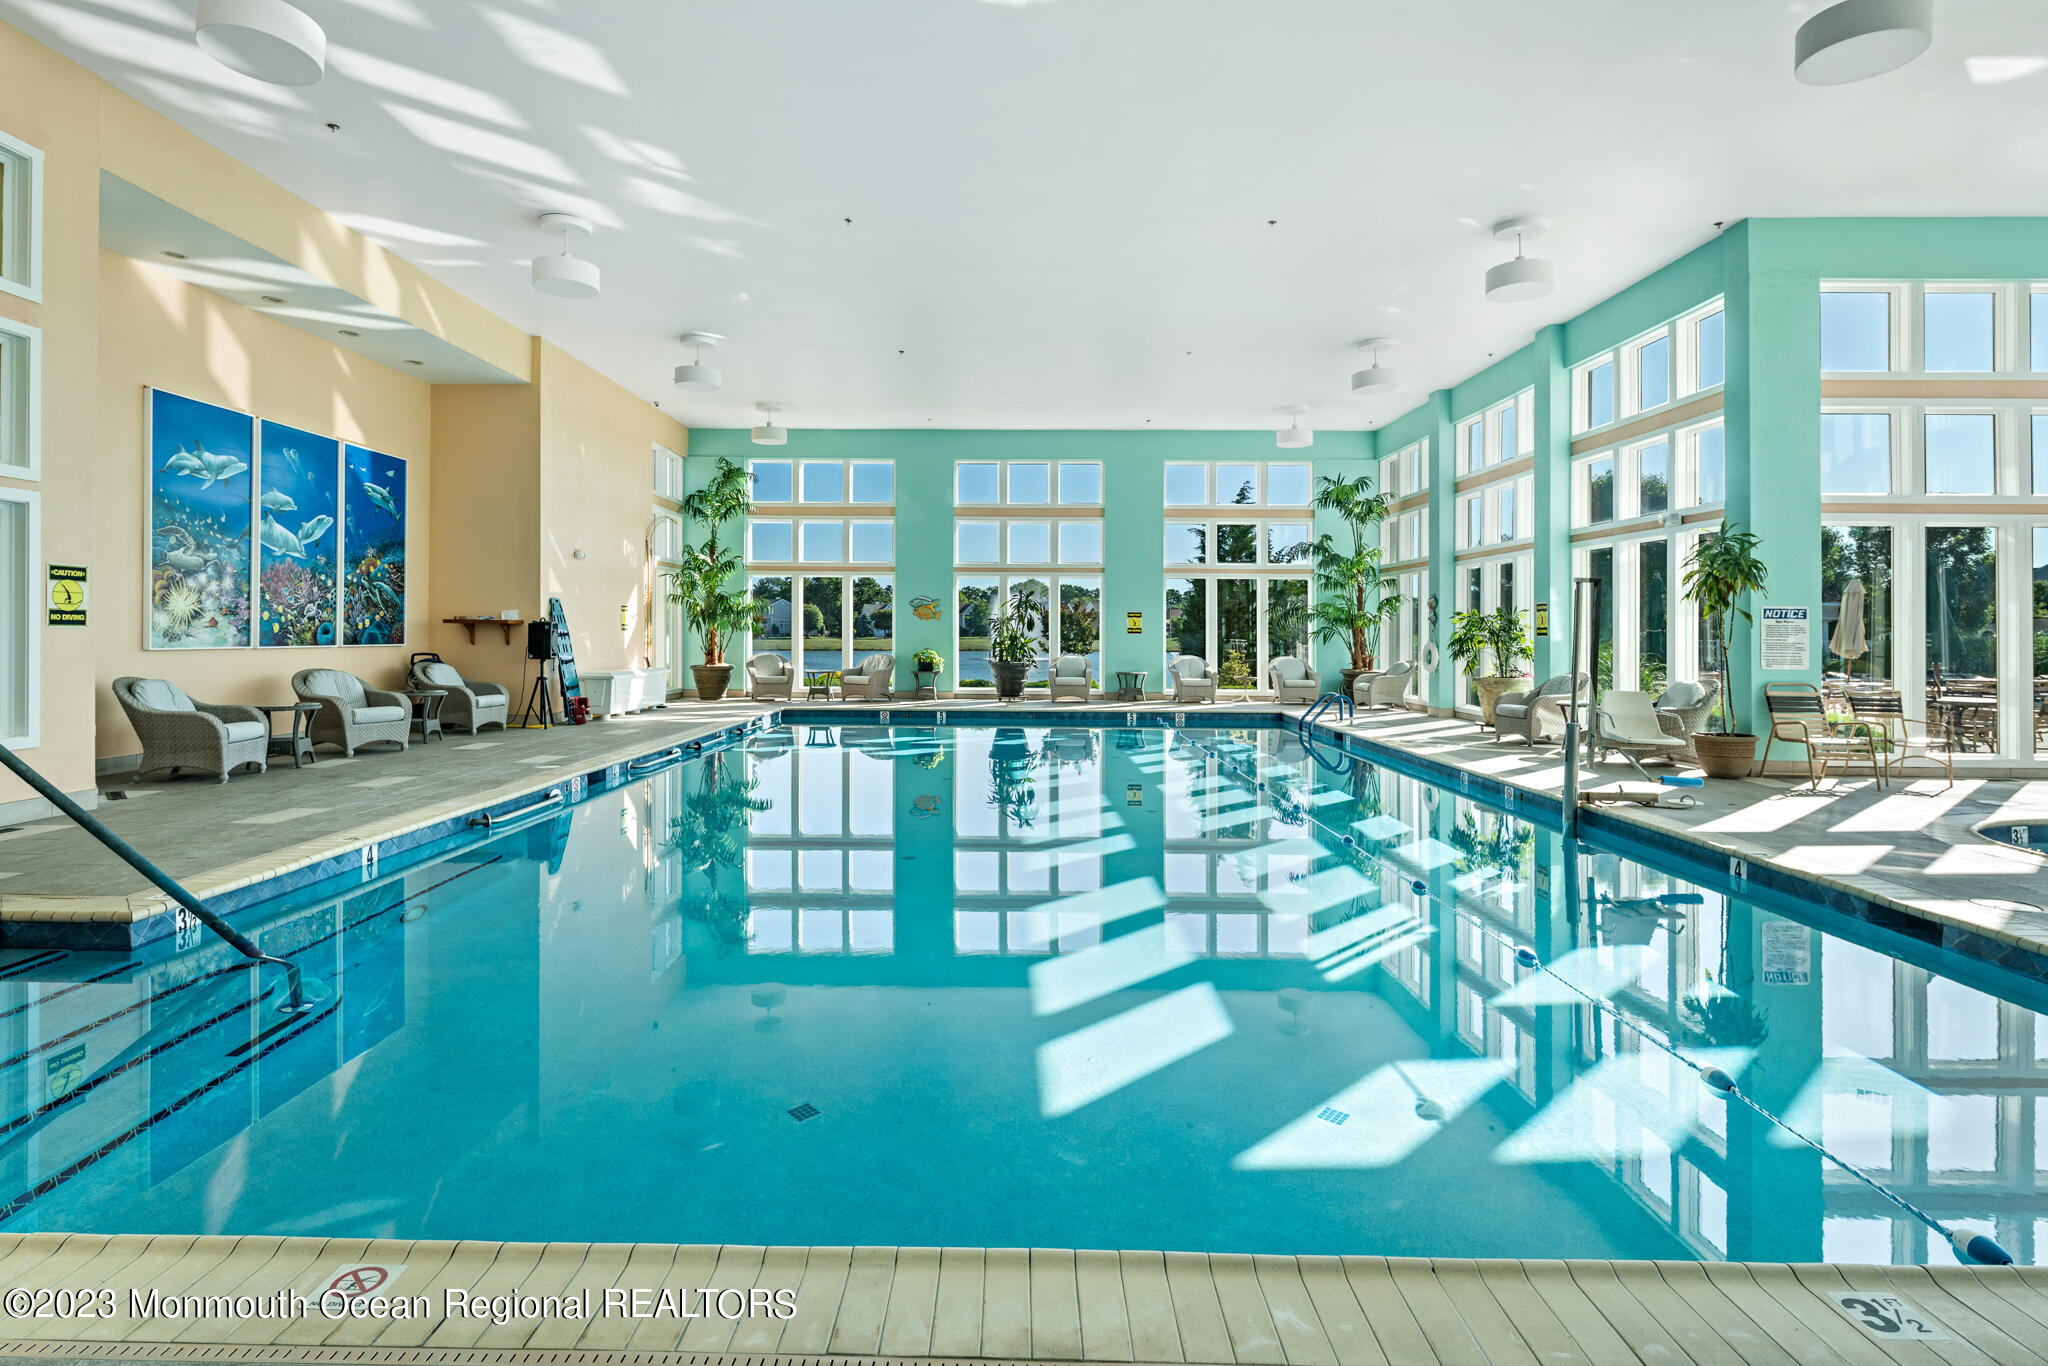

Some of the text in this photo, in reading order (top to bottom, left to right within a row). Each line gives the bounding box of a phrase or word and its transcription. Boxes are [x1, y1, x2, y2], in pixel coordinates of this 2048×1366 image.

[53, 569, 83, 577] CAUTION
[1765, 609, 1806, 618] NOTICE
[2012, 829, 2019, 843] 3
[366, 845, 374, 863] 4
[1734, 860, 1742, 877] 4
[178, 907, 187, 930] 3
[1841, 1298, 1900, 1333] 3
